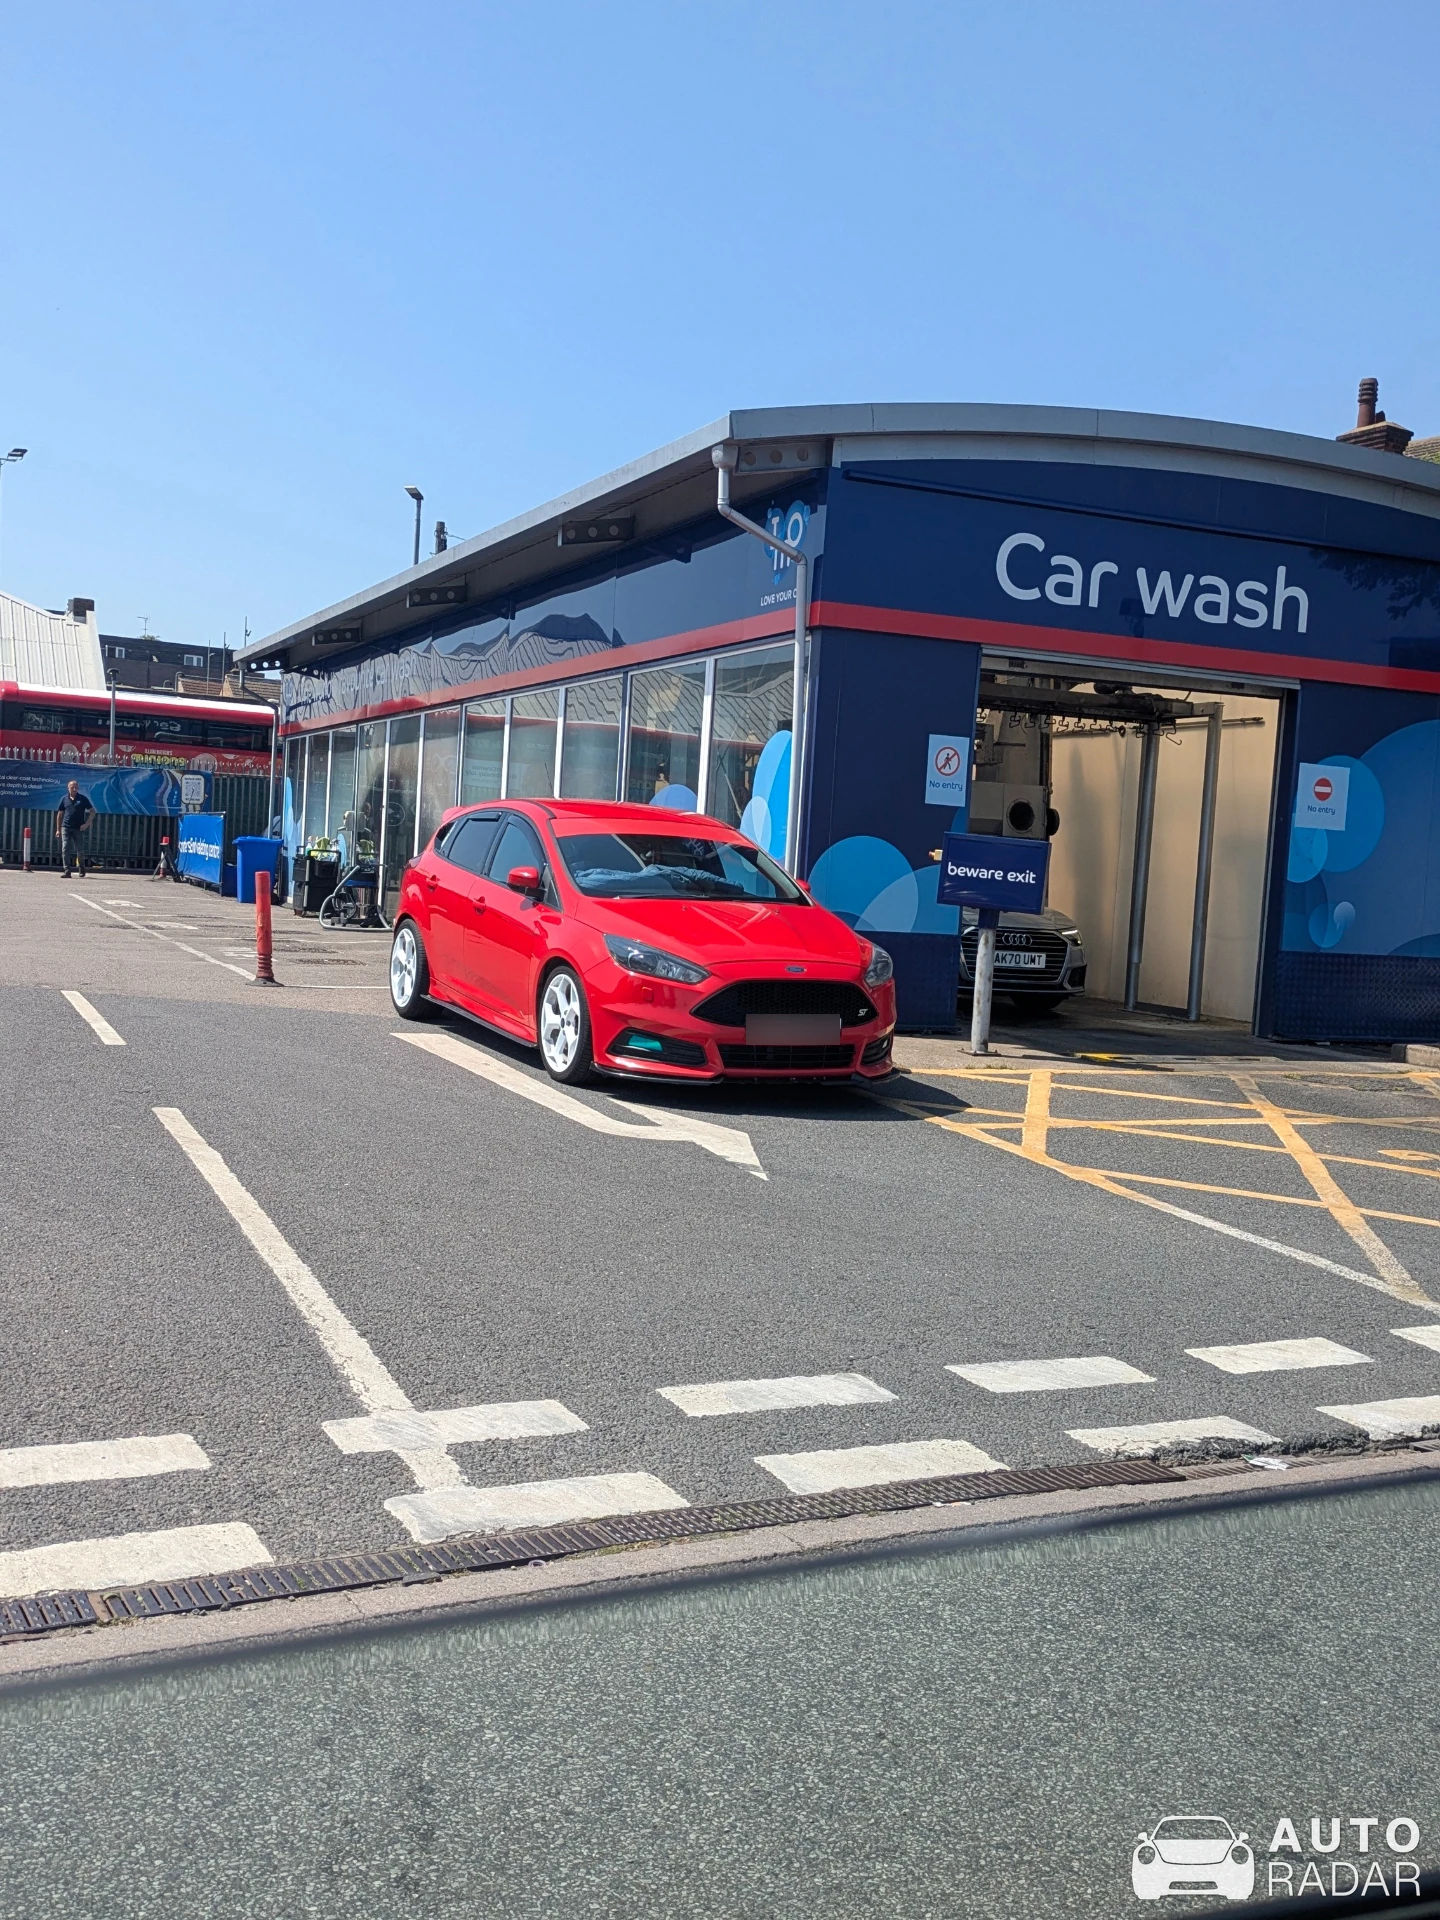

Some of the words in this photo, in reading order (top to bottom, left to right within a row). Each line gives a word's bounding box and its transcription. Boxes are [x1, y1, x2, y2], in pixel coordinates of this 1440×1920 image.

[995, 532, 1119, 608] Car
[1136, 565, 1309, 633] wash
[760, 593, 775, 607] LOVE
[776, 589, 792, 603] YOUR
[31, 777, 61, 785] technology
[929, 780, 940, 790] No
[941, 781, 963, 792] entry
[1307, 805, 1317, 813] No
[1317, 805, 1336, 816] entry
[947, 862, 1004, 881] beware
[1007, 869, 1037, 884] exit
[994, 952, 1021, 965] AK70
[1023, 954, 1042, 966] UMT
